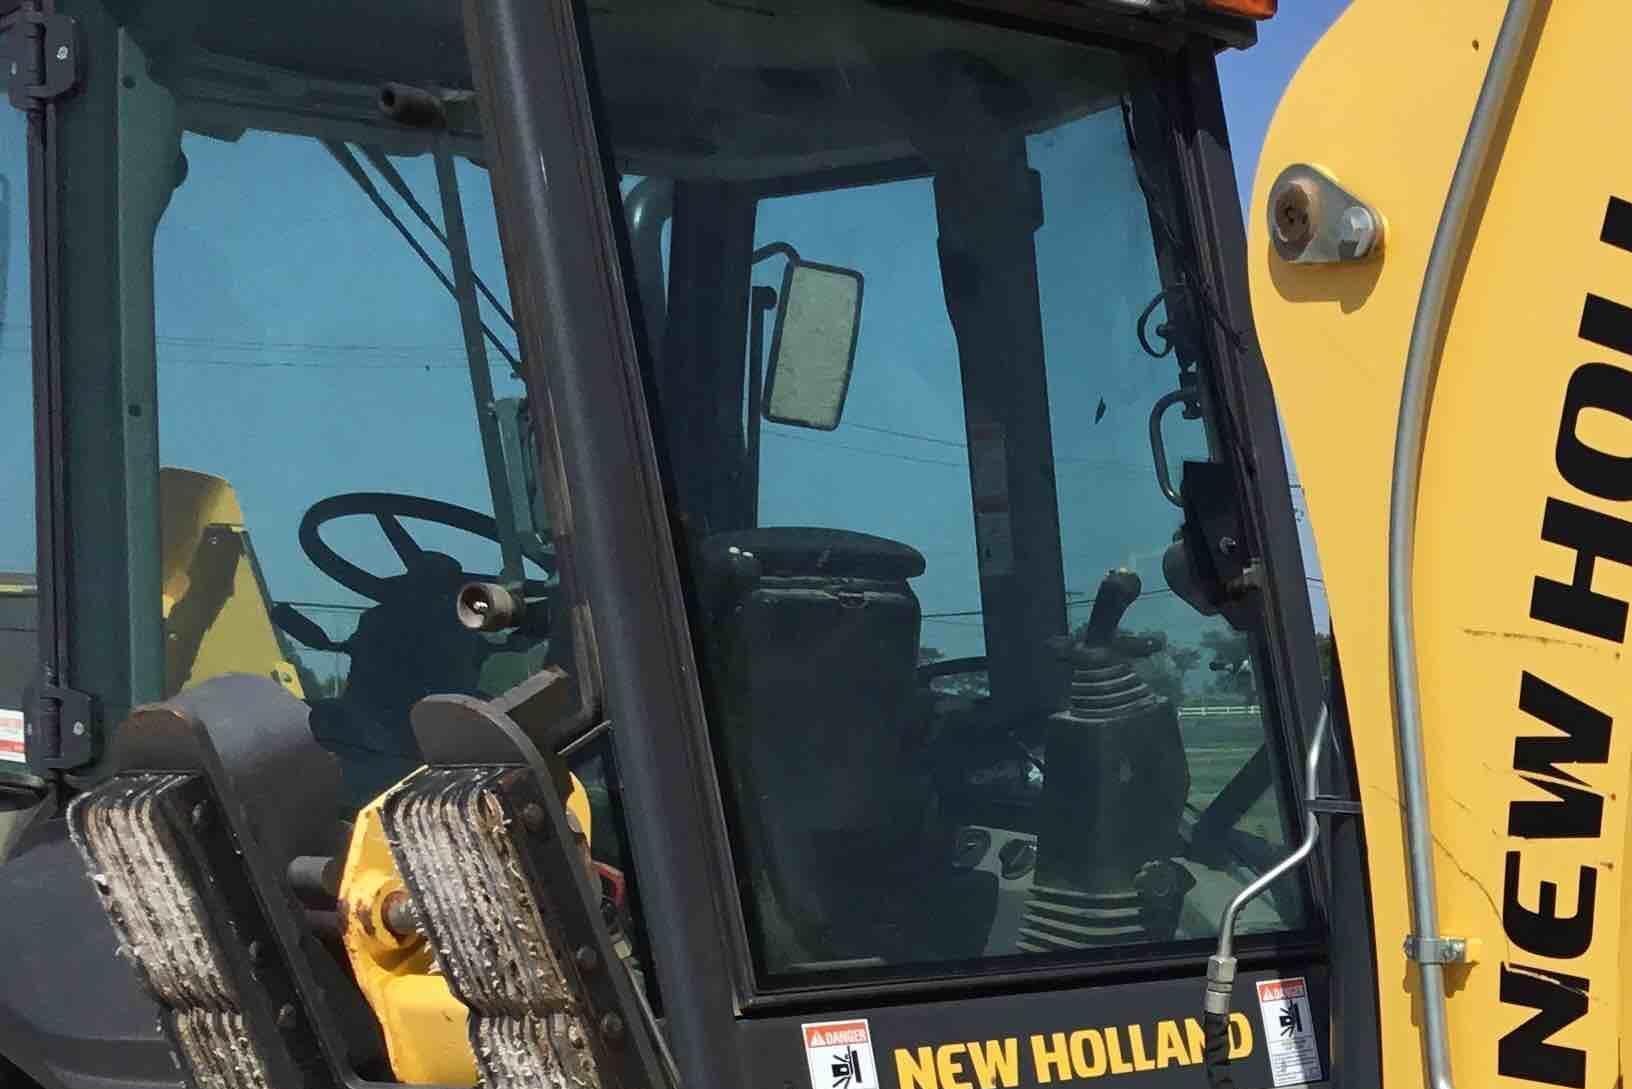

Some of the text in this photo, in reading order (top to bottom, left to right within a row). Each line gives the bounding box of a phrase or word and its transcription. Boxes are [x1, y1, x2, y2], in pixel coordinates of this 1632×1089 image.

[1498, 669, 1614, 1089] NEW
[825, 1031, 867, 1046] DANGER
[1030, 1012, 1253, 1083] HOLLAND
